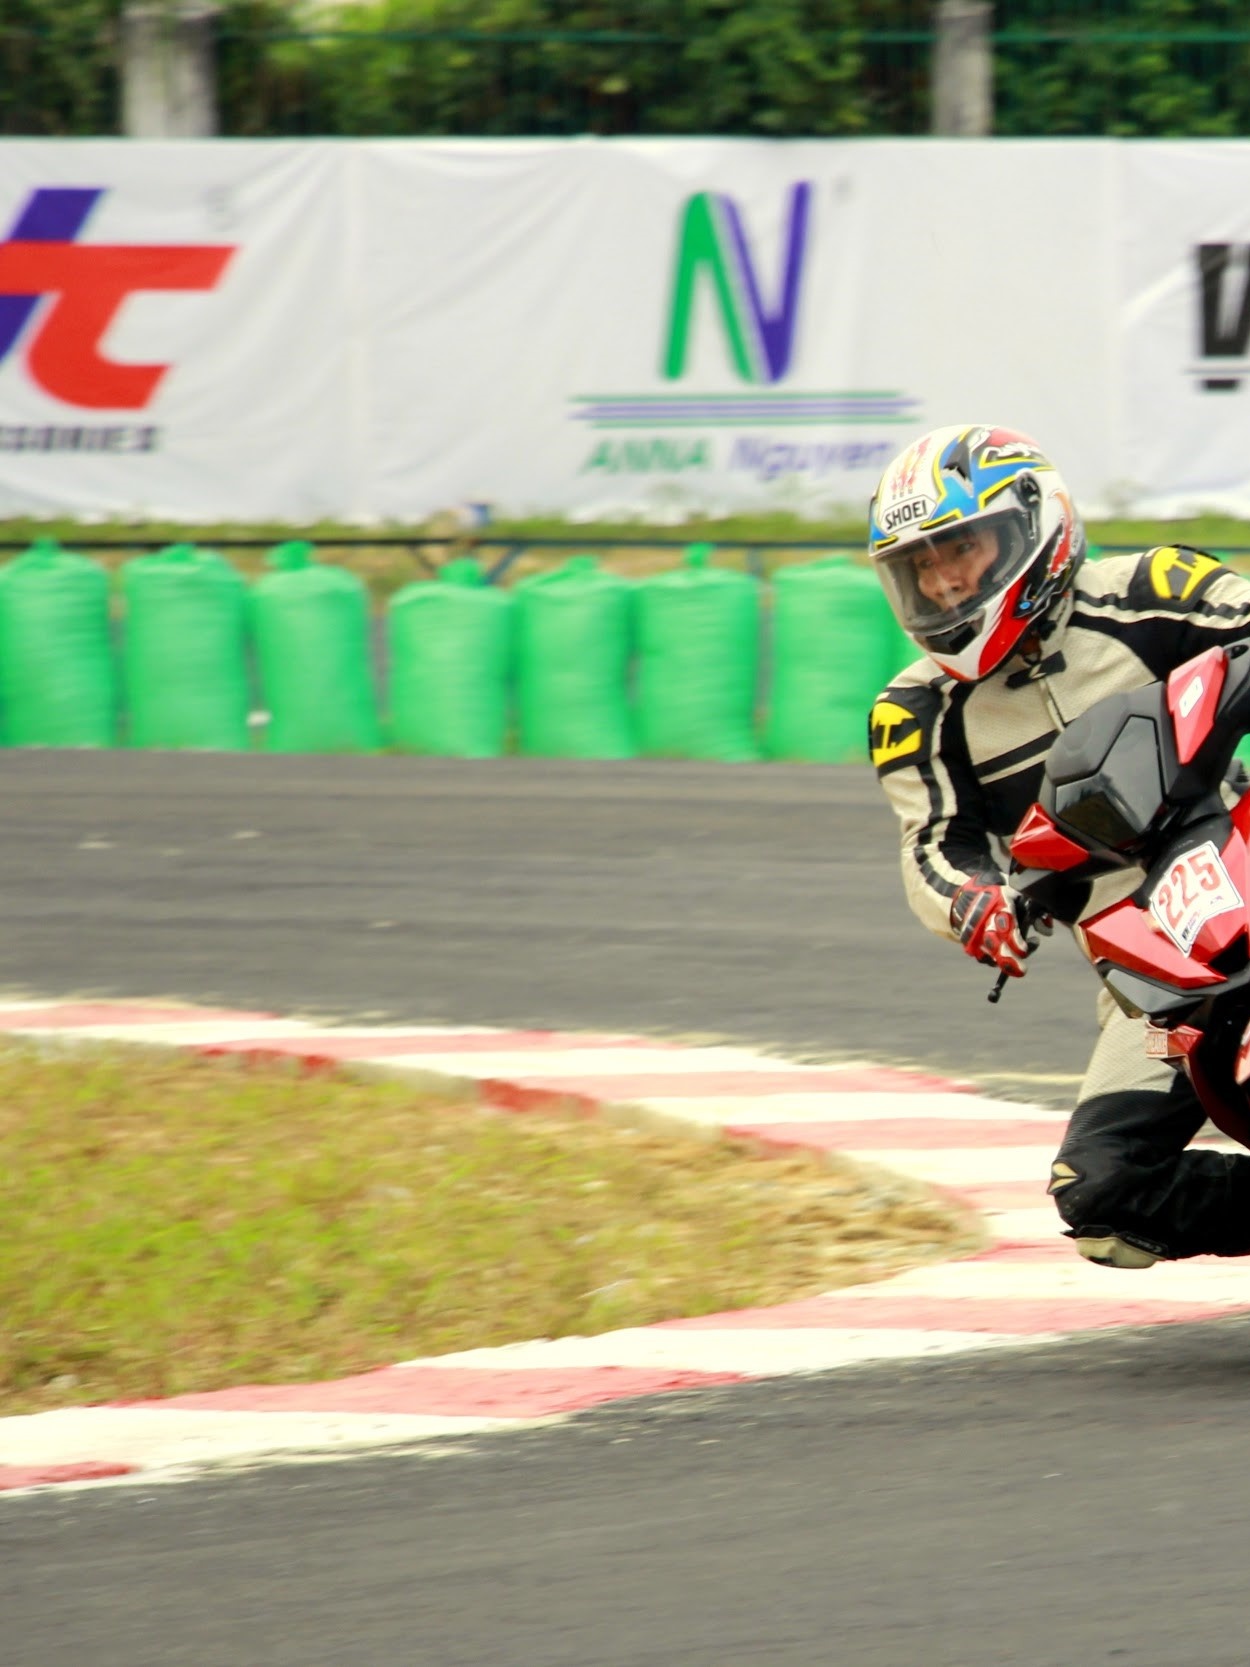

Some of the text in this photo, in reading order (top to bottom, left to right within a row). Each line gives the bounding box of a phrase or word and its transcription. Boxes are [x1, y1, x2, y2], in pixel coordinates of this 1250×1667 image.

[580, 436, 894, 482] ANNA Nguyen
[884, 499, 928, 531] SHOEI
[1158, 850, 1221, 931] 225
